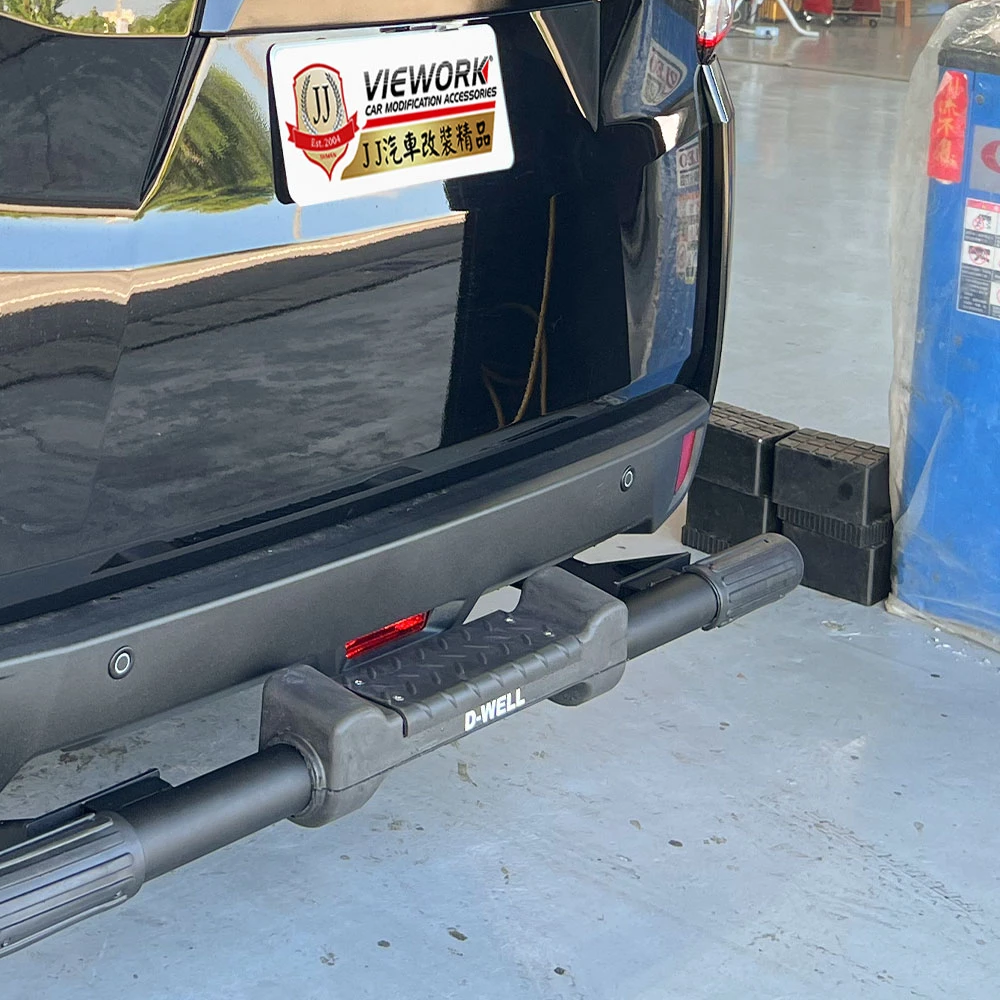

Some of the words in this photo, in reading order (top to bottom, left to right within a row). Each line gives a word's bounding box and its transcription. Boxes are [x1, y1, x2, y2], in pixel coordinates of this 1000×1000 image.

[363, 56, 489, 101] VIEWORK
[312, 85, 330, 124] JJ
[365, 103, 383, 116] CAR
[385, 94, 443, 113] MODIFICATION
[444, 86, 497, 105] ACCESSORIES
[465, 688, 526, 731] D-WELL
